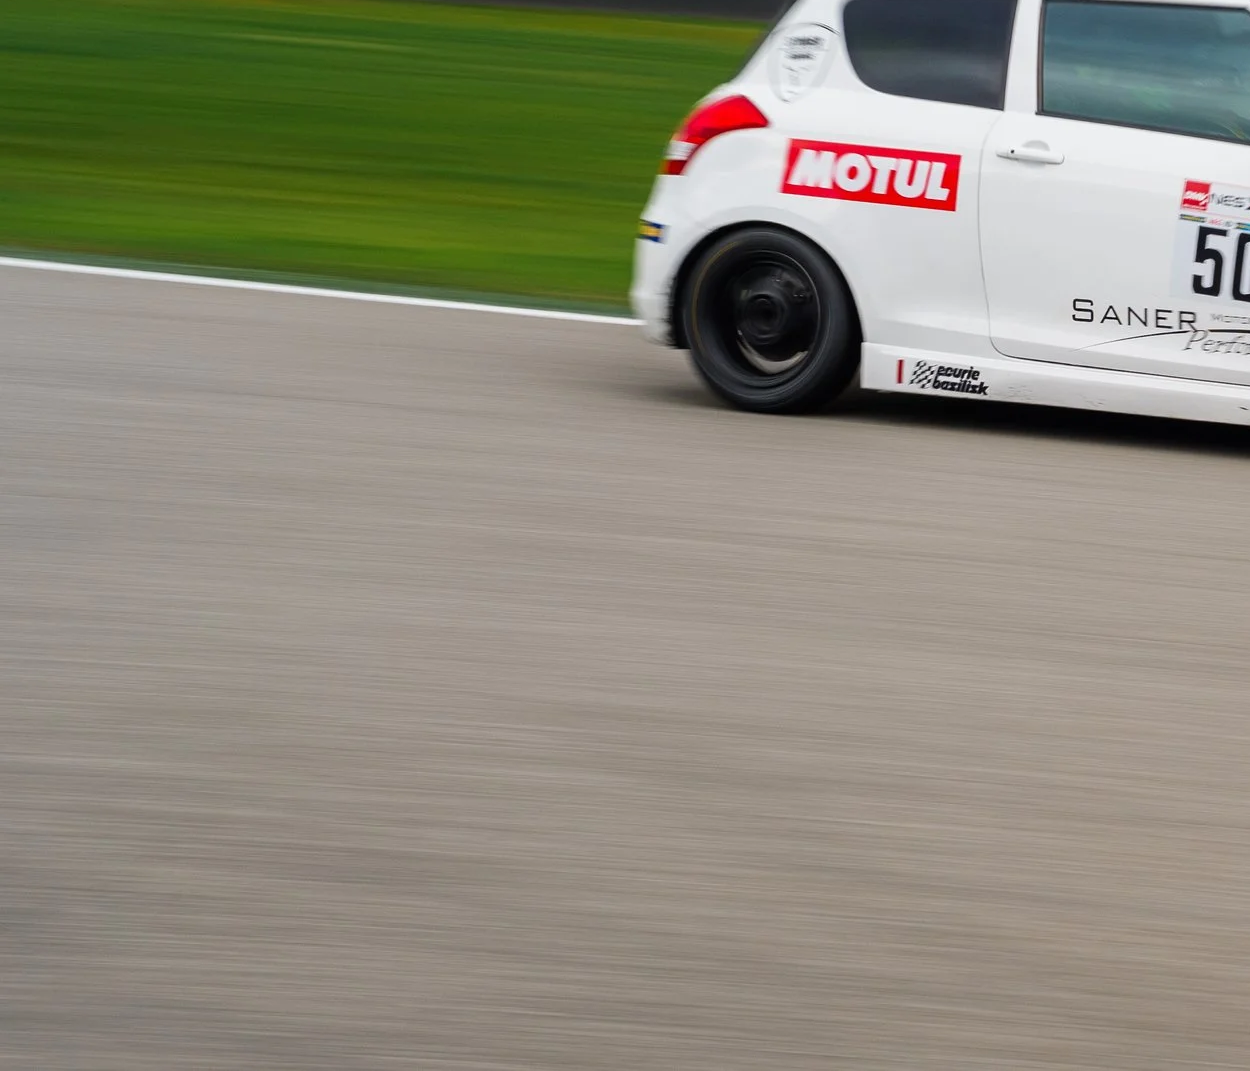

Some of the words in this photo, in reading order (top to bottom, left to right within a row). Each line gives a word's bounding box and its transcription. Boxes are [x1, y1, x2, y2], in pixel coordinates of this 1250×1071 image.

[787, 148, 950, 201] MOTUL
[1209, 193, 1246, 208] NES
[1072, 298, 1198, 332] SANER
[936, 365, 981, 381] ecurie
[932, 375, 990, 395] basilisk
